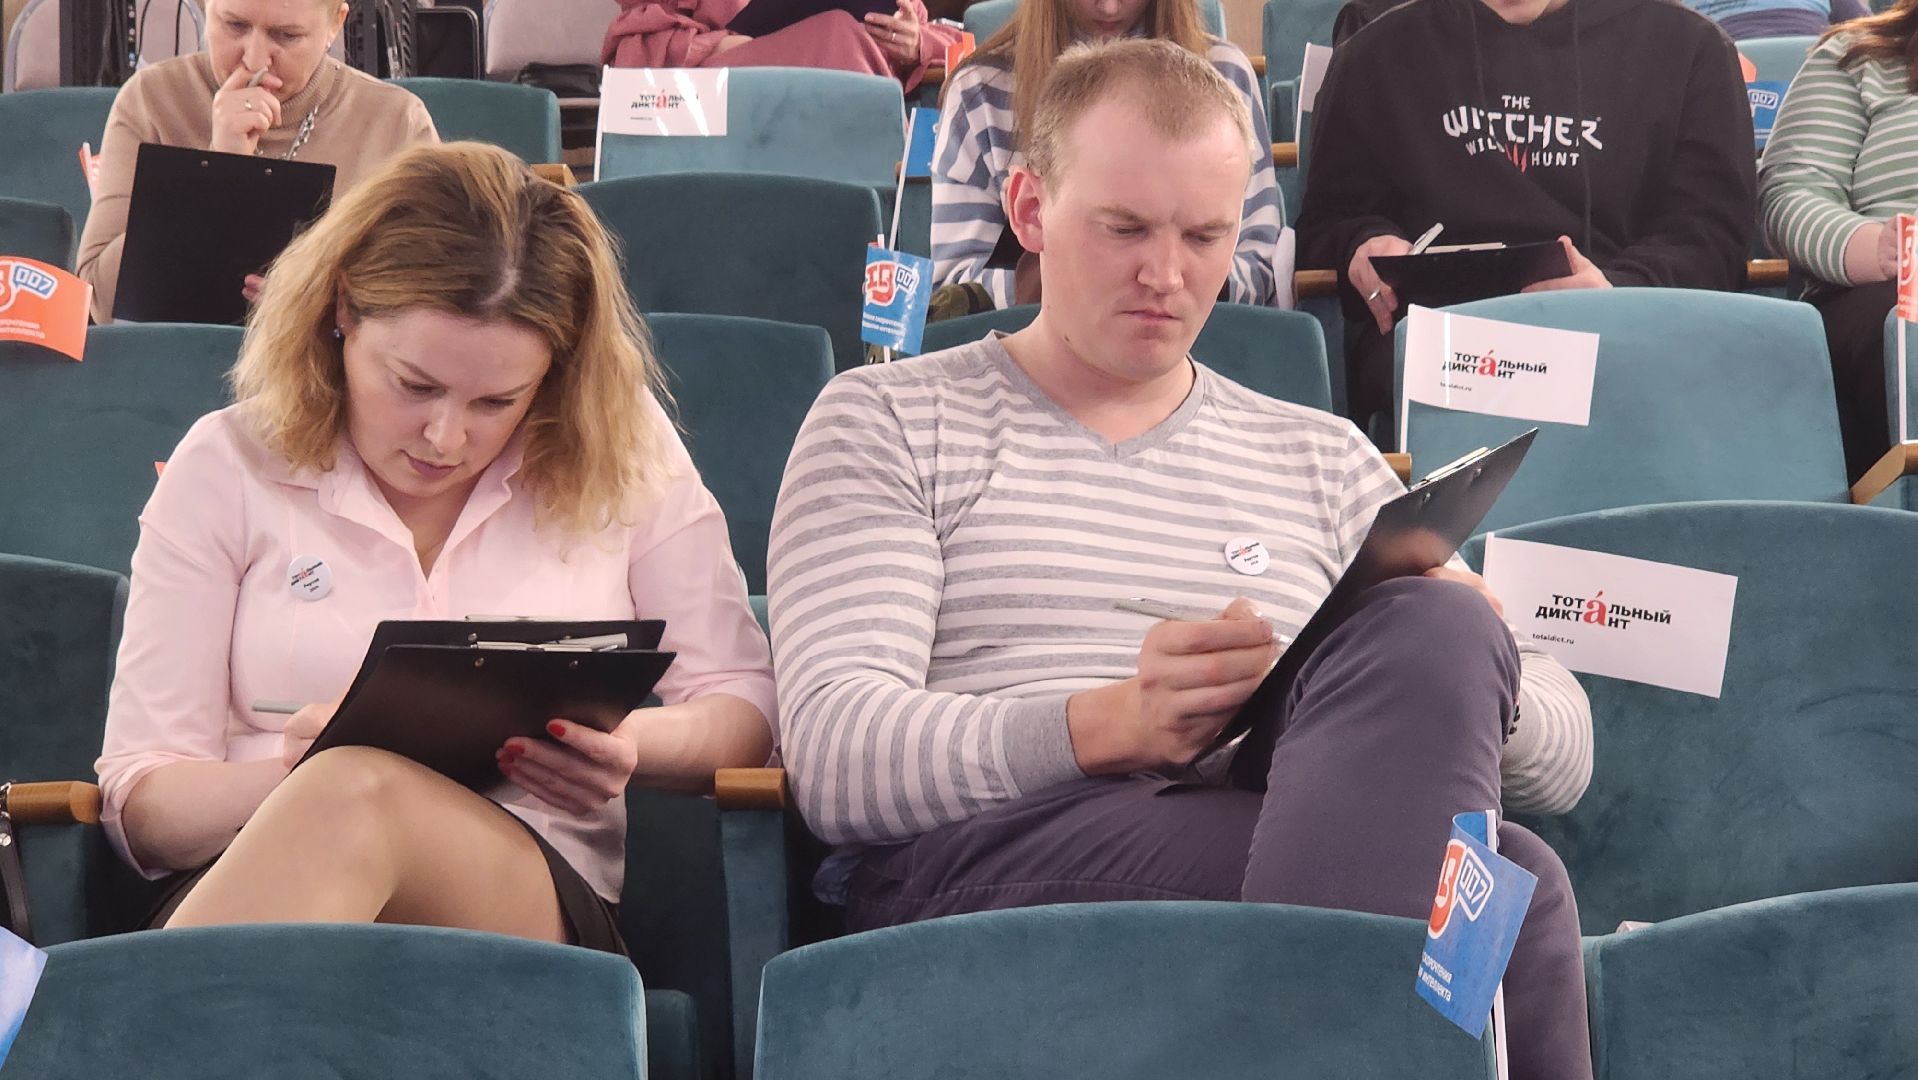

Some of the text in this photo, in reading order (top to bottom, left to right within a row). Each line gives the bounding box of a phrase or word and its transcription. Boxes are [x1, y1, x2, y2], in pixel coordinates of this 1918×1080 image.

[1502, 95, 1531, 110] THE
[1751, 92, 1775, 105] 007
[1443, 105, 1602, 150] WITCHER
[1465, 137, 1580, 167] WIL HUNT
[15, 267, 53, 291] 007
[1532, 633, 1575, 645] totaldict.ru
[1460, 858, 1487, 904] 007
